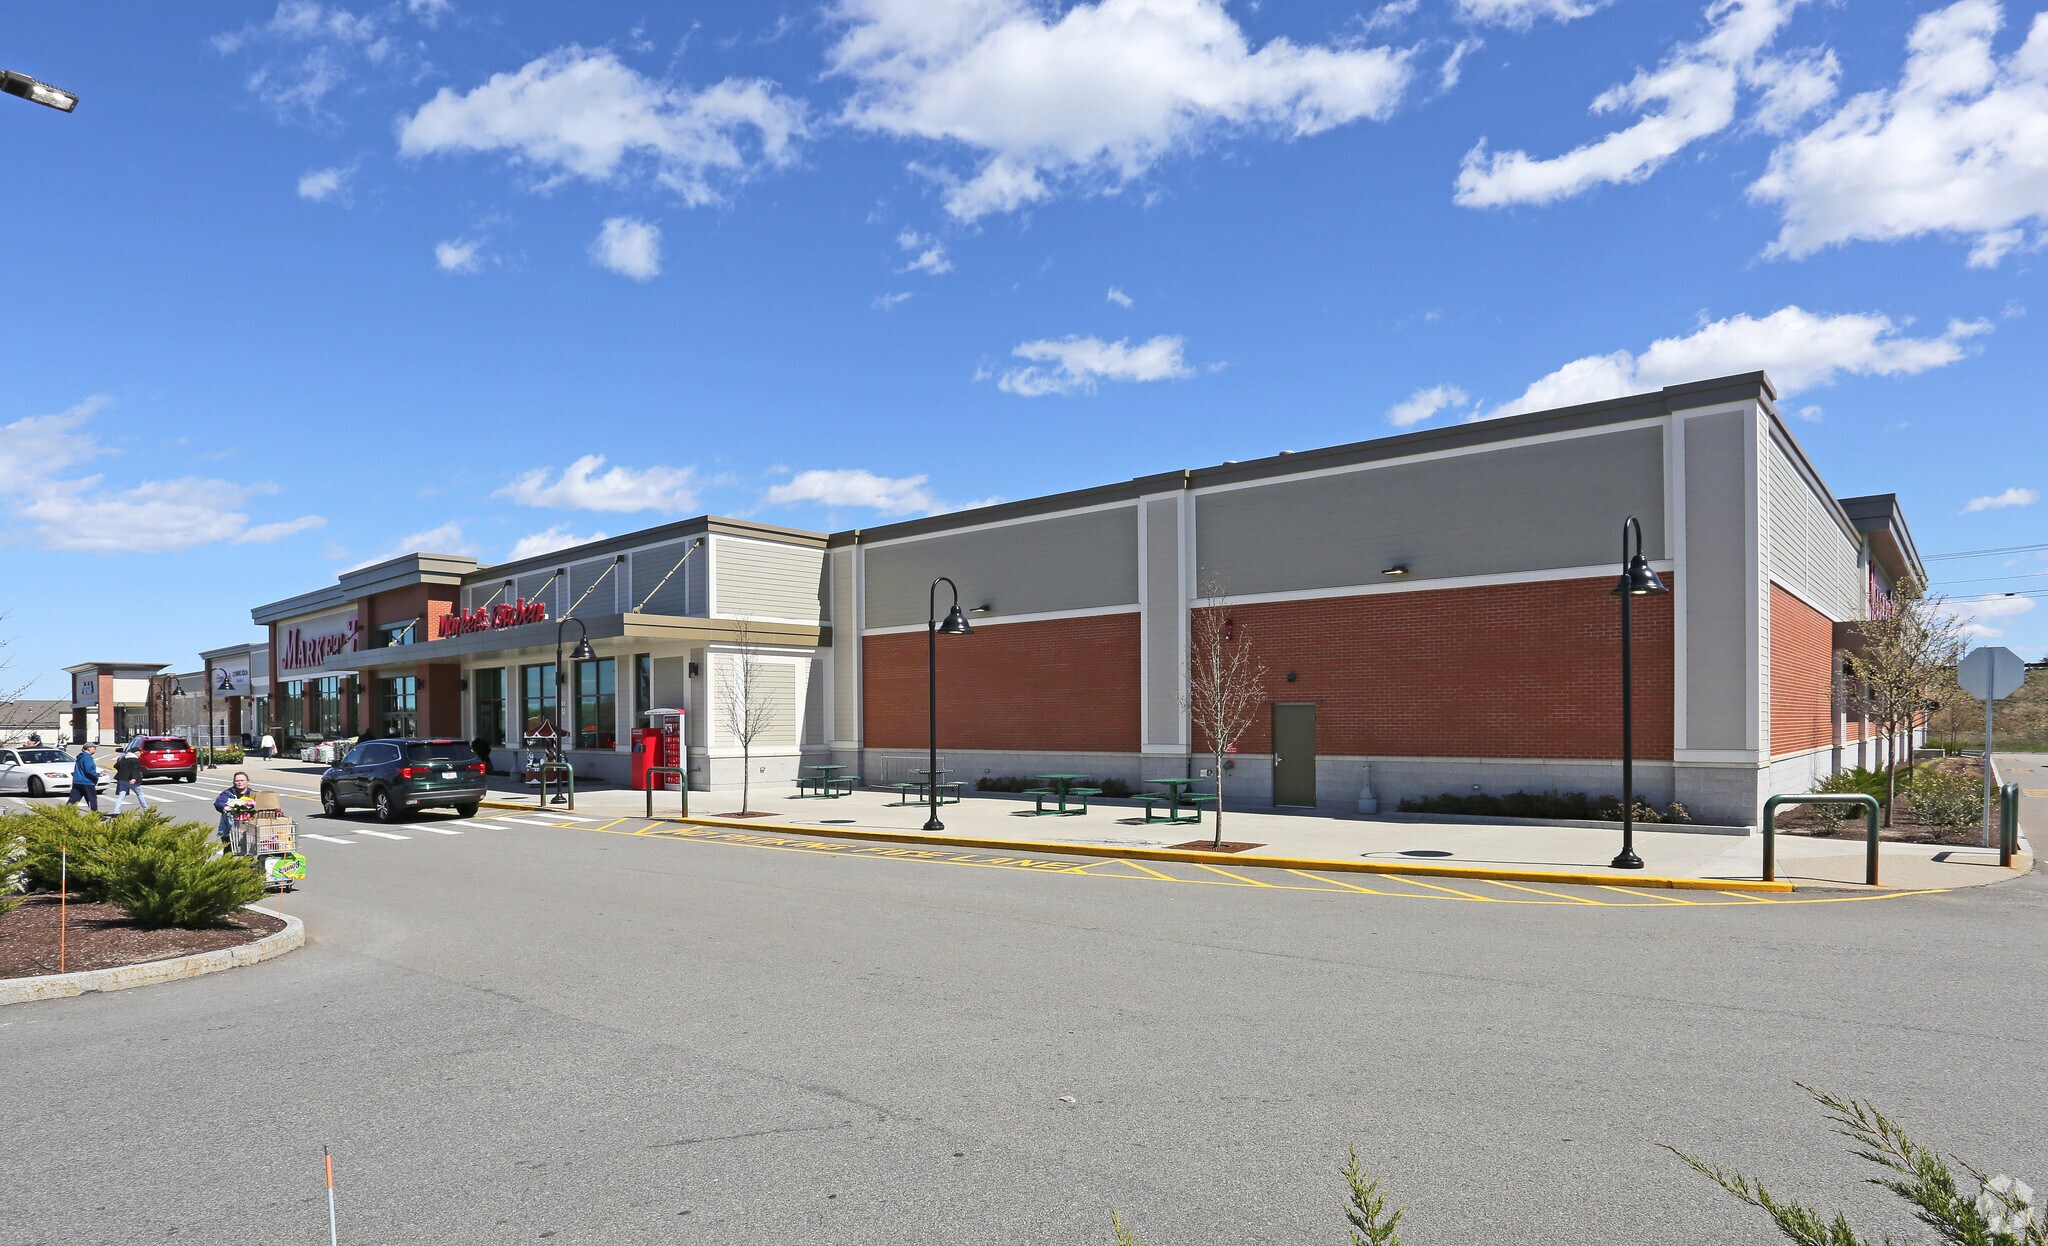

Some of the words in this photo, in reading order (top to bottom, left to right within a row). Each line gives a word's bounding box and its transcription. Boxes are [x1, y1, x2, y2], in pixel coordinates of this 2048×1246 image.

[706, 834, 857, 851] PARKING
[851, 842, 955, 859] FIRE
[946, 854, 1079, 870] LANE
